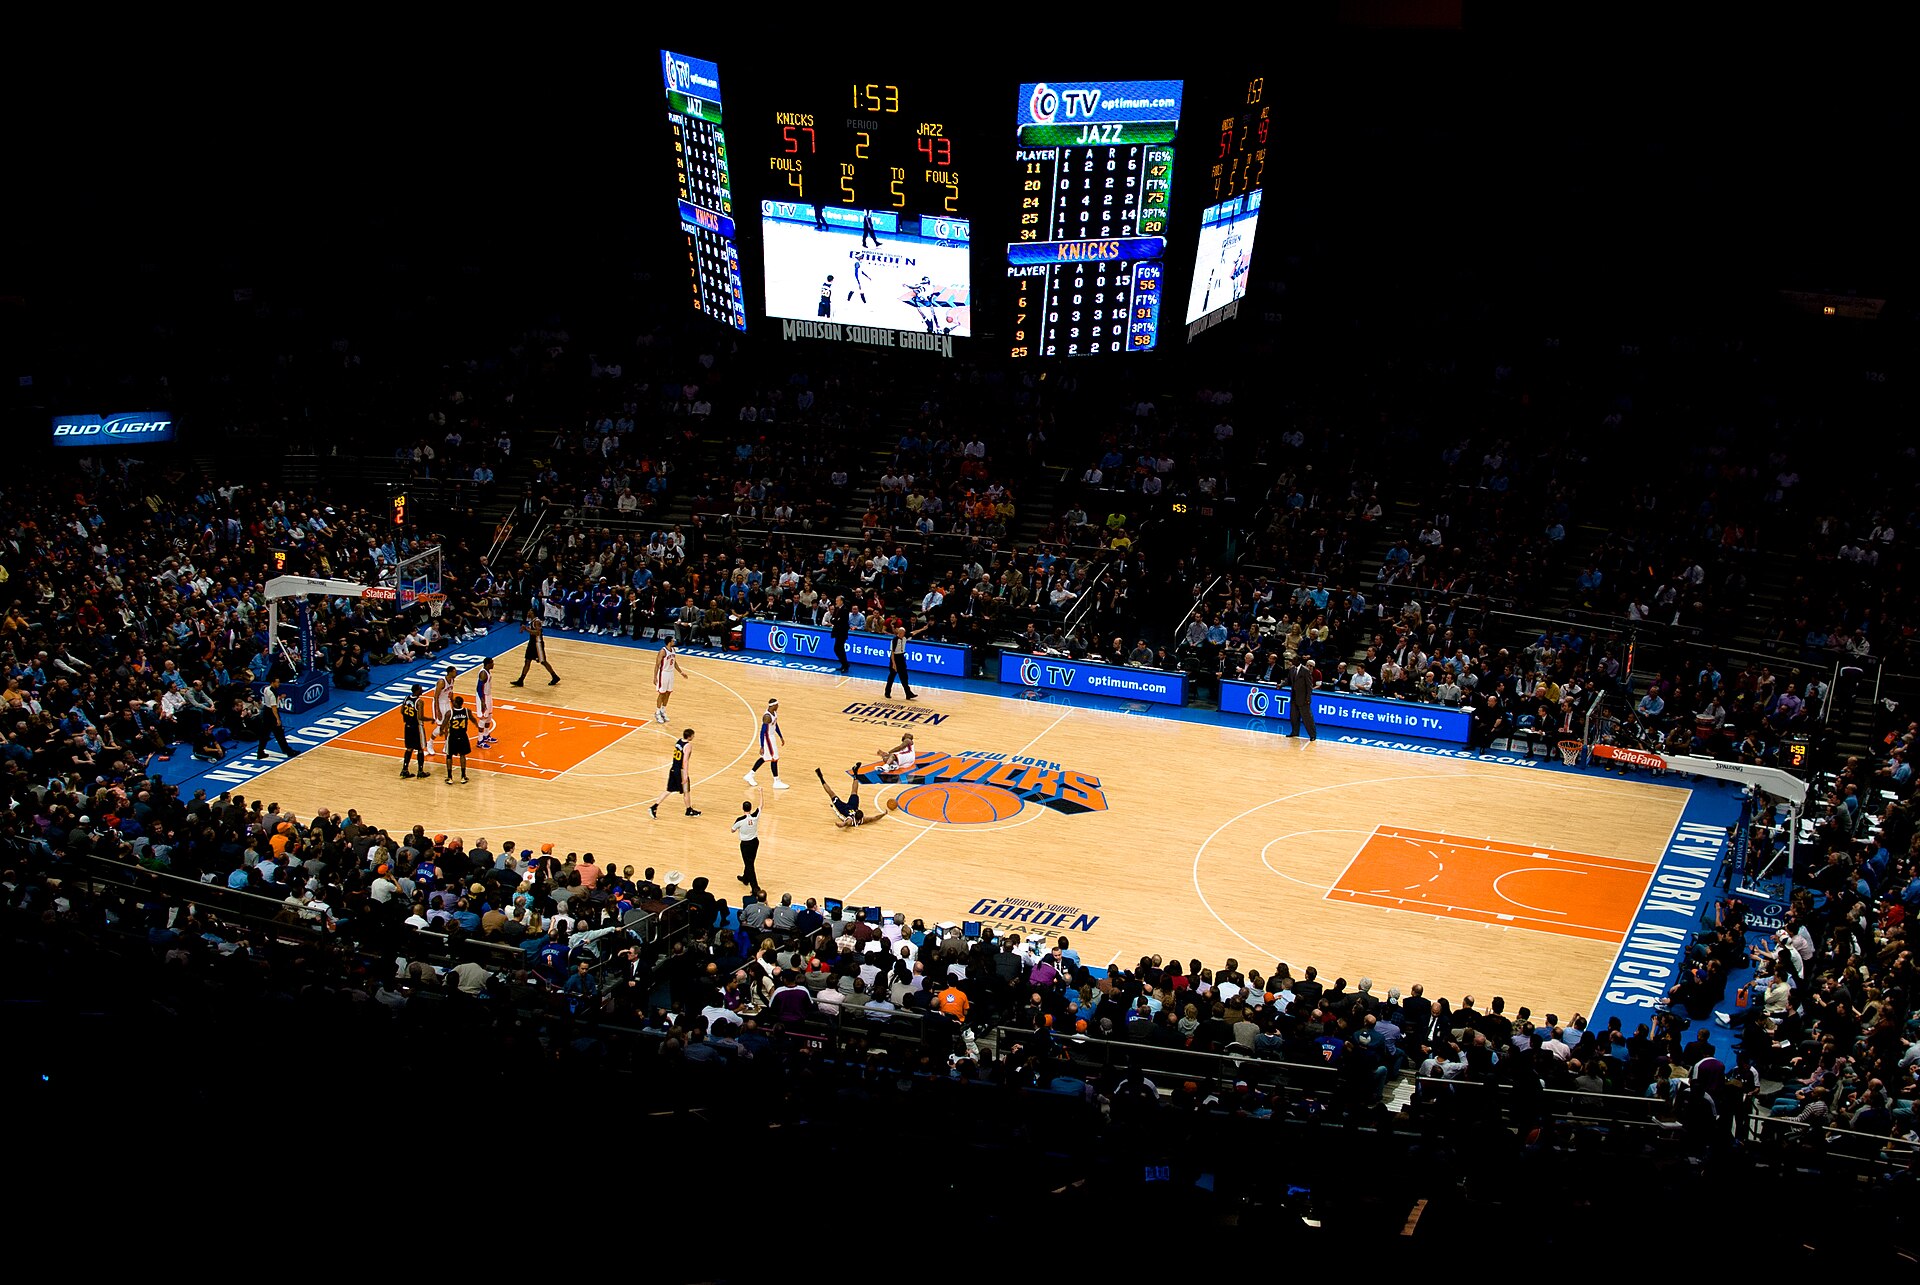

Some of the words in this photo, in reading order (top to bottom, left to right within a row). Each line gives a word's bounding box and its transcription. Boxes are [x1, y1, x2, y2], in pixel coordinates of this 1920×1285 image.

[854, 84, 898, 112] 1:53
[1064, 92, 1099, 116] TV
[1101, 98, 1175, 110] optimum.com
[777, 112, 813, 126] KNICKS
[846, 119, 878, 130] PERIOD
[917, 123, 942, 136] JAZZ
[1077, 125, 1122, 144] JAZZ
[784, 126, 815, 153] 57
[856, 132, 869, 159] 2
[918, 138, 950, 165] 43
[1016, 150, 1054, 161] PLAYER
[1065, 149, 1071, 159] F
[1087, 149, 1092, 158] A
[1109, 148, 1115, 158] R
[1131, 147, 1137, 156] P
[1149, 151, 1171, 161] FG%
[770, 158, 802, 171] FOULS
[841, 163, 854, 176] TO
[1027, 163, 1040, 173] 11
[1063, 162, 1069, 172] 1
[1085, 161, 1093, 171] 2
[1107, 160, 1115, 170] 0
[1128, 160, 1136, 170] 6
[1151, 166, 1166, 176] 47
[891, 167, 904, 180] TO
[926, 170, 958, 184] FOULS
[789, 173, 802, 197] 4
[841, 176, 854, 202] 5
[1025, 180, 1040, 190] 20
[1061, 179, 1069, 189] 0
[1084, 178, 1090, 188] 1
[1106, 178, 1114, 187] 2
[1127, 177, 1135, 187] 5
[1146, 180, 1168, 189] FT%
[891, 180, 905, 207] 5
[945, 185, 958, 211] 2
[1148, 193, 1164, 202] 75
[1023, 197, 1039, 208] 24
[1060, 196, 1066, 206] 1
[1082, 196, 1089, 205] 4
[1104, 195, 1112, 204] 2
[1125, 194, 1133, 204] 2
[1022, 214, 1038, 224] 25
[1059, 212, 1064, 222] 1
[1080, 211, 1089, 221] 0
[1103, 211, 1110, 220] 6
[1121, 210, 1136, 219] 14
[1143, 208, 1166, 218] 3PT%
[1021, 230, 1036, 239] 34
[1058, 228, 1063, 238] 1
[1080, 227, 1086, 237] 1
[1101, 226, 1109, 236] 2
[1122, 225, 1130, 235] 2
[1146, 222, 1161, 231] 20
[1058, 242, 1119, 261] KNICKS
[1008, 266, 1045, 276] PLAYER
[1055, 265, 1061, 274] F
[1076, 264, 1083, 273] A
[1099, 263, 1105, 272] R
[1121, 262, 1127, 271] P
[1138, 268, 1159, 278] FG%
[1021, 281, 1026, 290] 1
[1054, 279, 1059, 289] 1
[1075, 278, 1083, 287] 0
[1097, 277, 1105, 286] 0
[1115, 275, 1130, 285] 15
[1140, 280, 1155, 290] 56
[1019, 298, 1026, 307] 6
[1052, 296, 1058, 305] 1
[1073, 295, 1082, 304] 0
[1096, 293, 1103, 303] 3
[1117, 292, 1124, 302] 4
[1136, 295, 1157, 305] FT%
[1017, 315, 1025, 324] 7
[1050, 312, 1058, 322] 0
[1072, 311, 1080, 321] 3
[1094, 310, 1102, 320] 3
[1112, 309, 1127, 318] 16
[1137, 309, 1151, 318] 91
[1016, 331, 1024, 340] 9
[1049, 329, 1055, 339] 1
[1071, 328, 1079, 337] 3
[1093, 326, 1100, 336] 2
[1113, 325, 1121, 335] 0
[1132, 322, 1154, 332] 3PT%
[783, 319, 841, 341] MADISON
[846, 326, 895, 346] SQUARE
[900, 329, 956, 357] GARDEN
[1135, 335, 1150, 345] 58
[1012, 347, 1027, 357] 25
[1047, 346, 1055, 355] 2
[1069, 344, 1077, 354] 2
[1091, 343, 1099, 352] 2
[1112, 342, 1120, 351] 0
[53, 424, 101, 436] BUD
[109, 421, 171, 433] LIGHT
[397, 507, 405, 524] 2
[277, 560, 284, 570] 2
[366, 588, 396, 600] StateFar
[793, 633, 820, 653] TV
[853, 643, 862, 653] is
[864, 645, 885, 656] free
[926, 653, 945, 665] TV.
[1046, 665, 1075, 686] TV
[1088, 674, 1166, 694] optimum.com
[285, 702, 381, 746] YORK
[367, 651, 487, 703] KNICKS
[306, 686, 321, 698] KIA
[404, 705, 415, 717] 25
[842, 703, 949, 726] GARDEN
[1275, 695, 1290, 714] T
[1319, 704, 1336, 716] HD
[1339, 707, 1349, 718] is
[1351, 707, 1374, 721] free
[1377, 711, 1402, 724] with
[1421, 716, 1443, 730] TV.
[452, 719, 467, 729] 24
[849, 716, 915, 730] CHASE
[1338, 735, 1538, 768] NYKNICKS.COM
[1612, 748, 1662, 768] StateFarm
[957, 750, 1007, 762] NEW
[1012, 755, 1061, 771] YORK
[1716, 763, 1743, 772] SPALDING
[1793, 755, 1801, 766] 2
[1670, 821, 1727, 861] NEW
[1644, 864, 1712, 917] YORK
[1004, 897, 1045, 910] MADISON
[1046, 903, 1082, 915] SQUARE
[968, 898, 1100, 932] GARDEN
[981, 920, 1062, 938] CHASE
[1605, 922, 1687, 1008] KNICKS
[1322, 1051, 1332, 1062] 7
